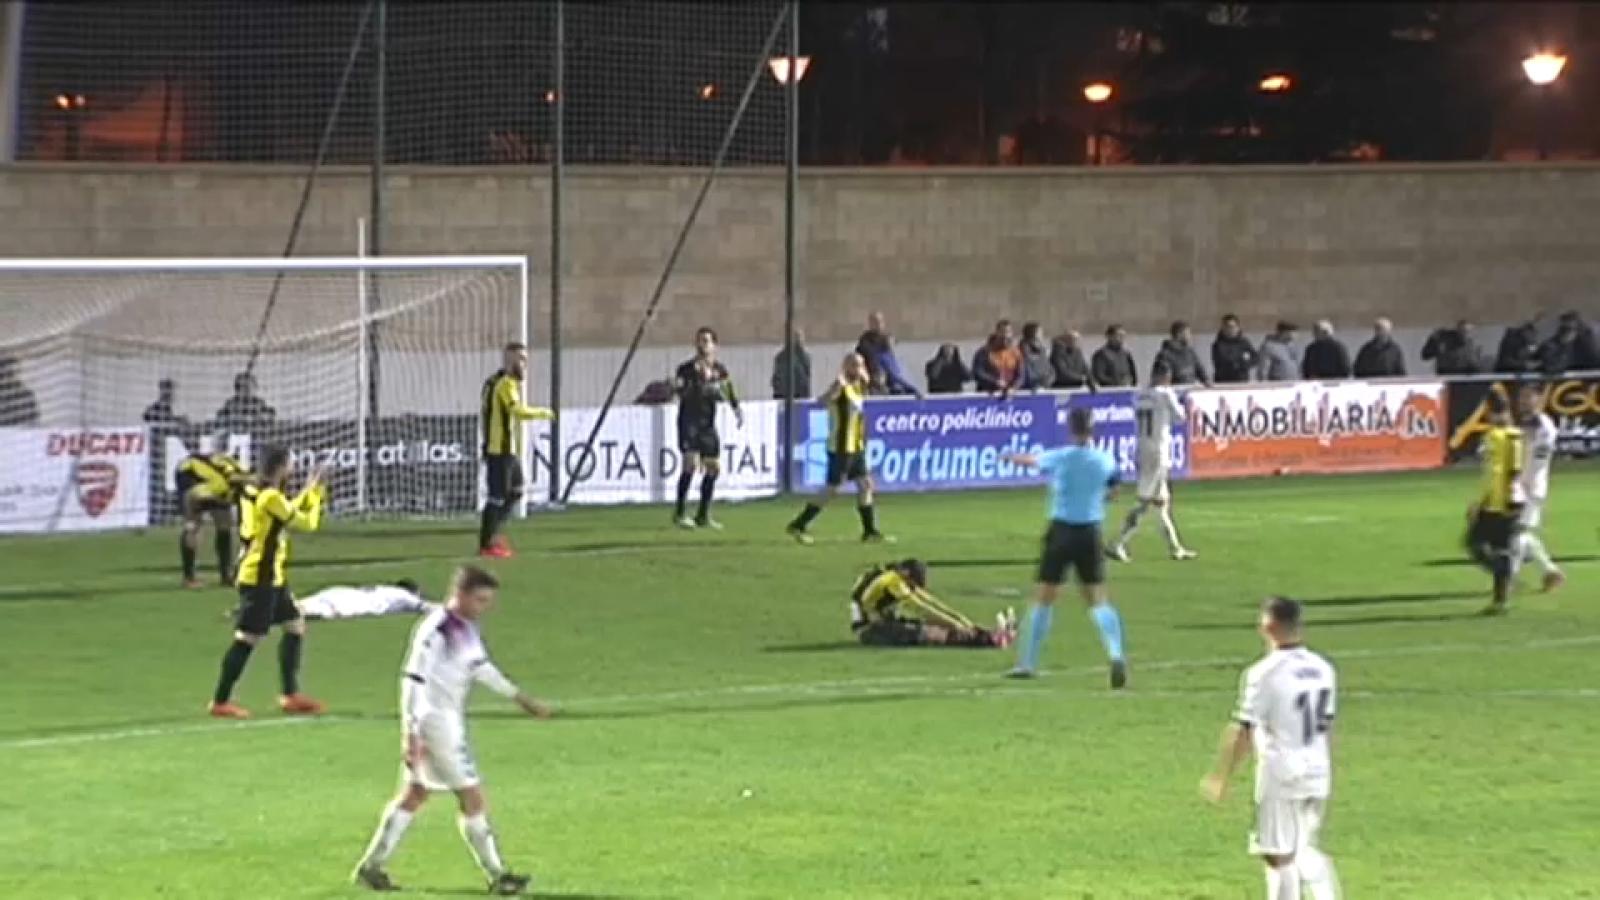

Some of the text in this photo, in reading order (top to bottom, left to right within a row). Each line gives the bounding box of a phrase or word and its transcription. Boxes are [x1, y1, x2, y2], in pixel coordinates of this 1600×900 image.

[875, 405, 1033, 436] centro policlínico
[1191, 404, 1393, 439] INMOBILIARIA
[47, 432, 145, 456] DUCATI
[659, 442, 771, 476] DTAL
